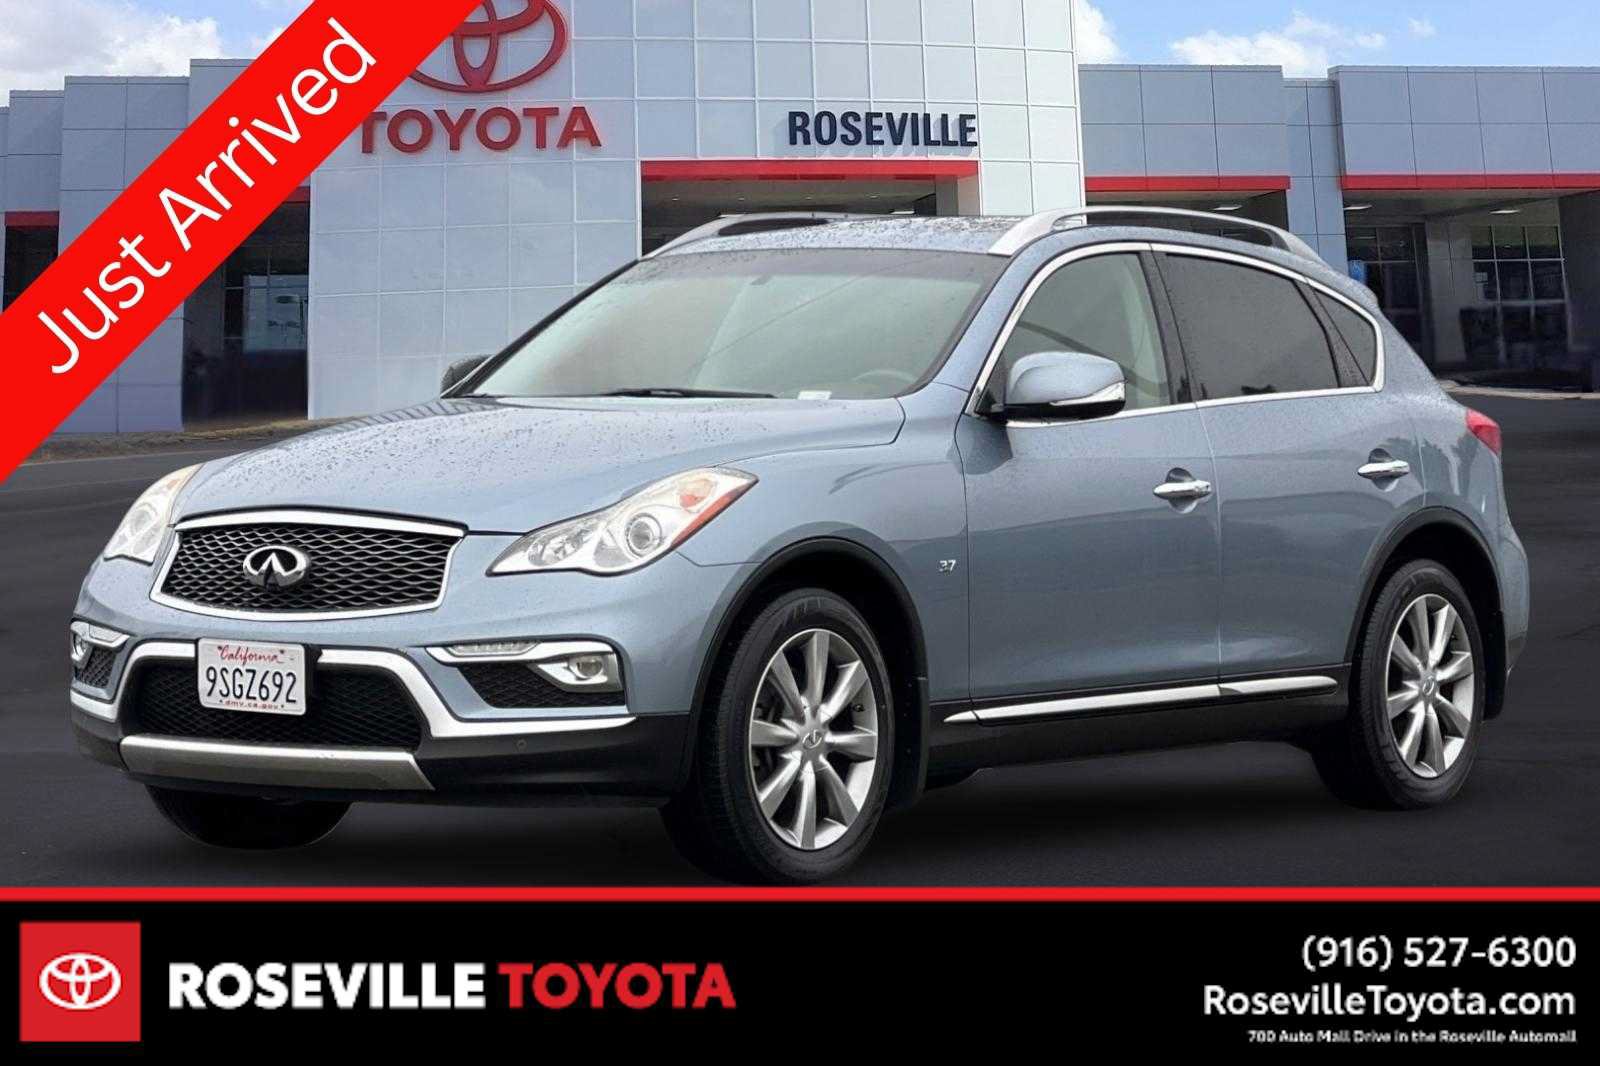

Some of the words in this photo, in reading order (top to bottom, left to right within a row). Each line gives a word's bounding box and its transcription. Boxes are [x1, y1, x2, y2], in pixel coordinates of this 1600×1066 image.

[361, 106, 602, 154] TOYOTA
[787, 110, 978, 148] ROSEVILLE
[219, 644, 284, 666] California
[206, 666, 297, 703] 9SGZ692
